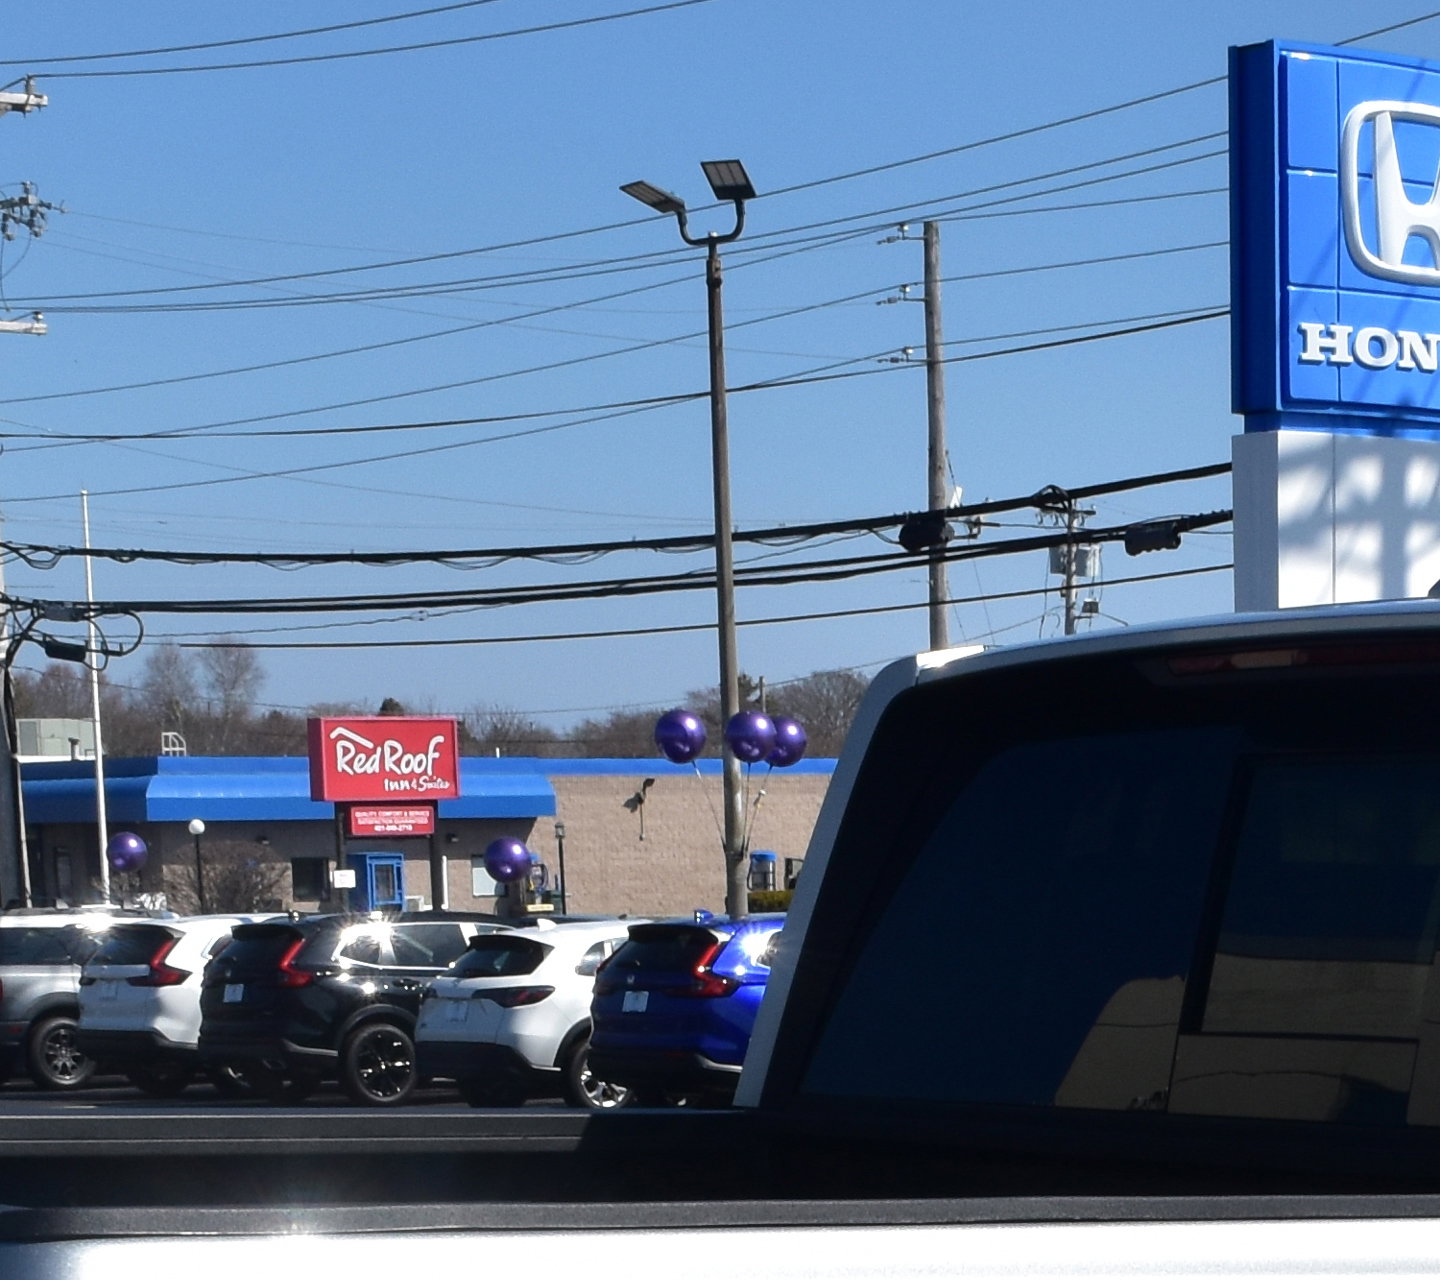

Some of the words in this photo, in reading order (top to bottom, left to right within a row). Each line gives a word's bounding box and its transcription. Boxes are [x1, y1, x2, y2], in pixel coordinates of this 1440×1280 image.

[336, 740, 381, 775] Red
[384, 736, 445, 776] Roof
[384, 778, 410, 791] Inn
